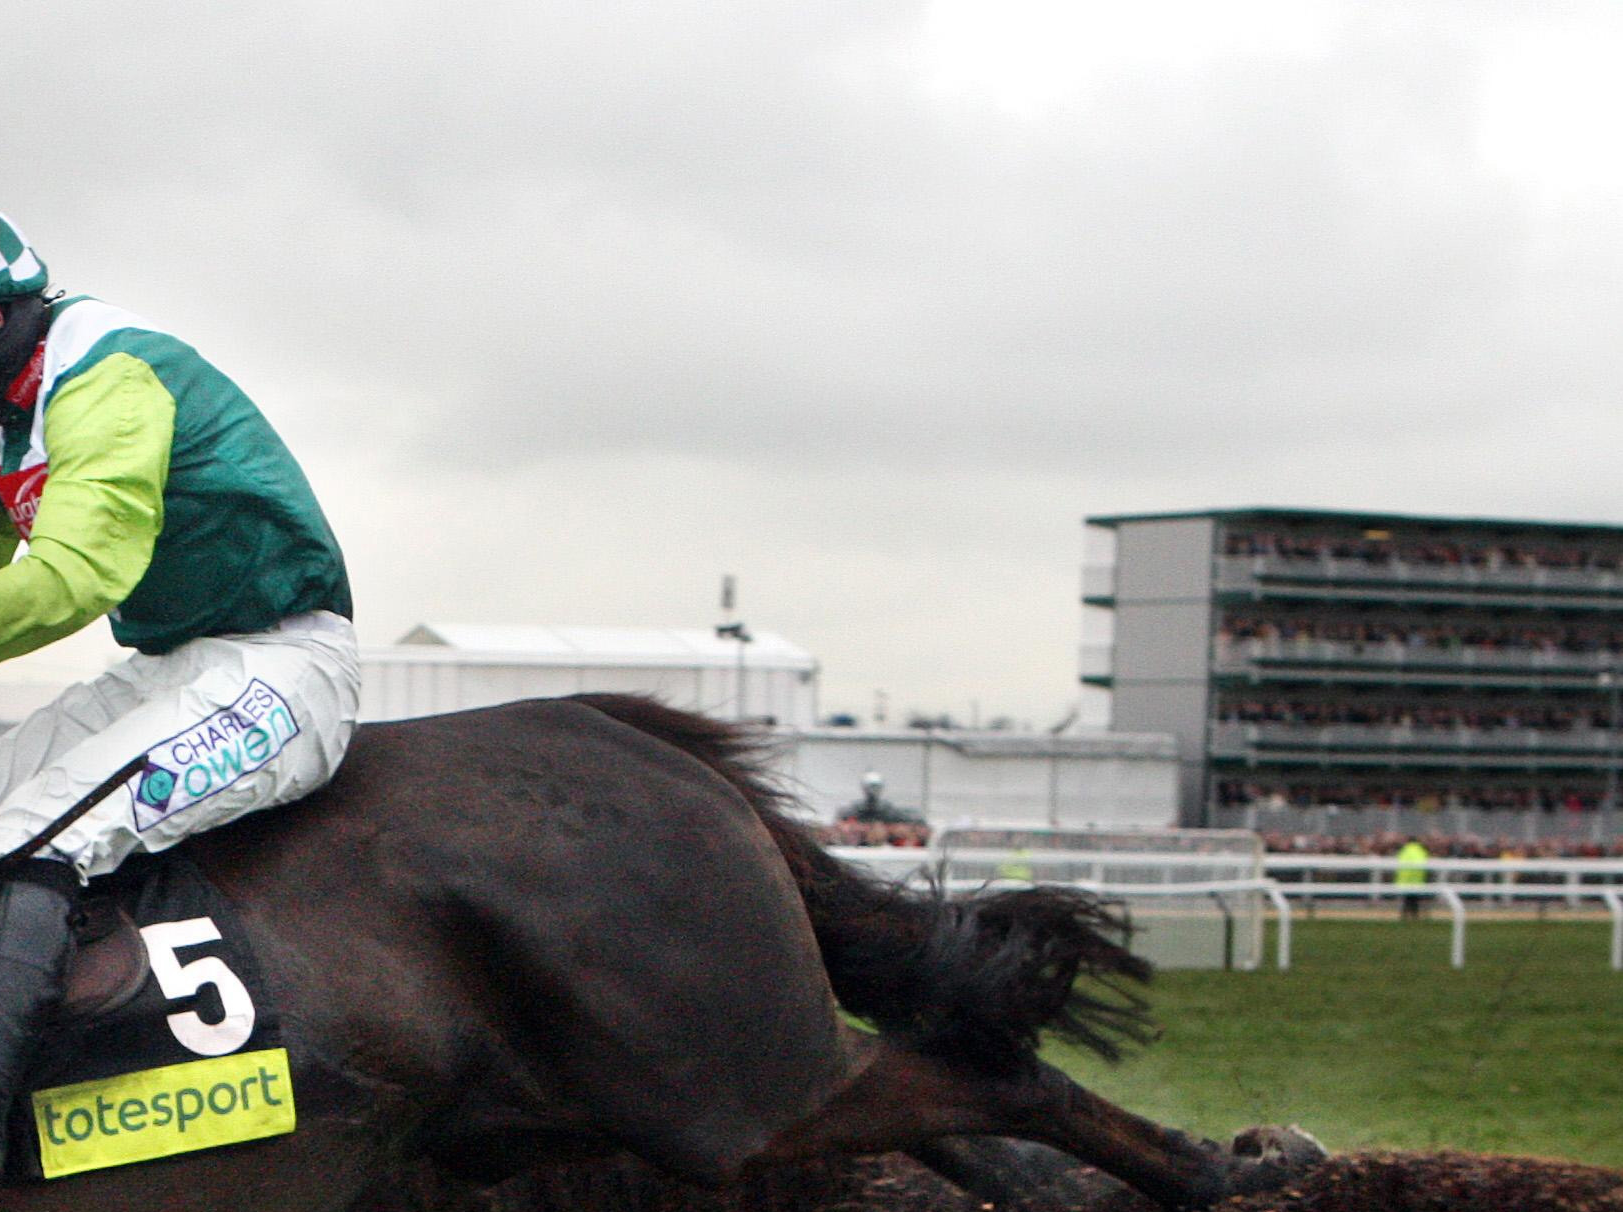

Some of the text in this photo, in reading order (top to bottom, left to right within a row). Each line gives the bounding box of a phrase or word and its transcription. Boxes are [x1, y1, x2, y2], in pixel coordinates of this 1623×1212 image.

[172, 688, 274, 765] CHARLES
[184, 706, 295, 797] owen
[139, 916, 256, 1057] 5
[43, 1066, 282, 1146] totesport
